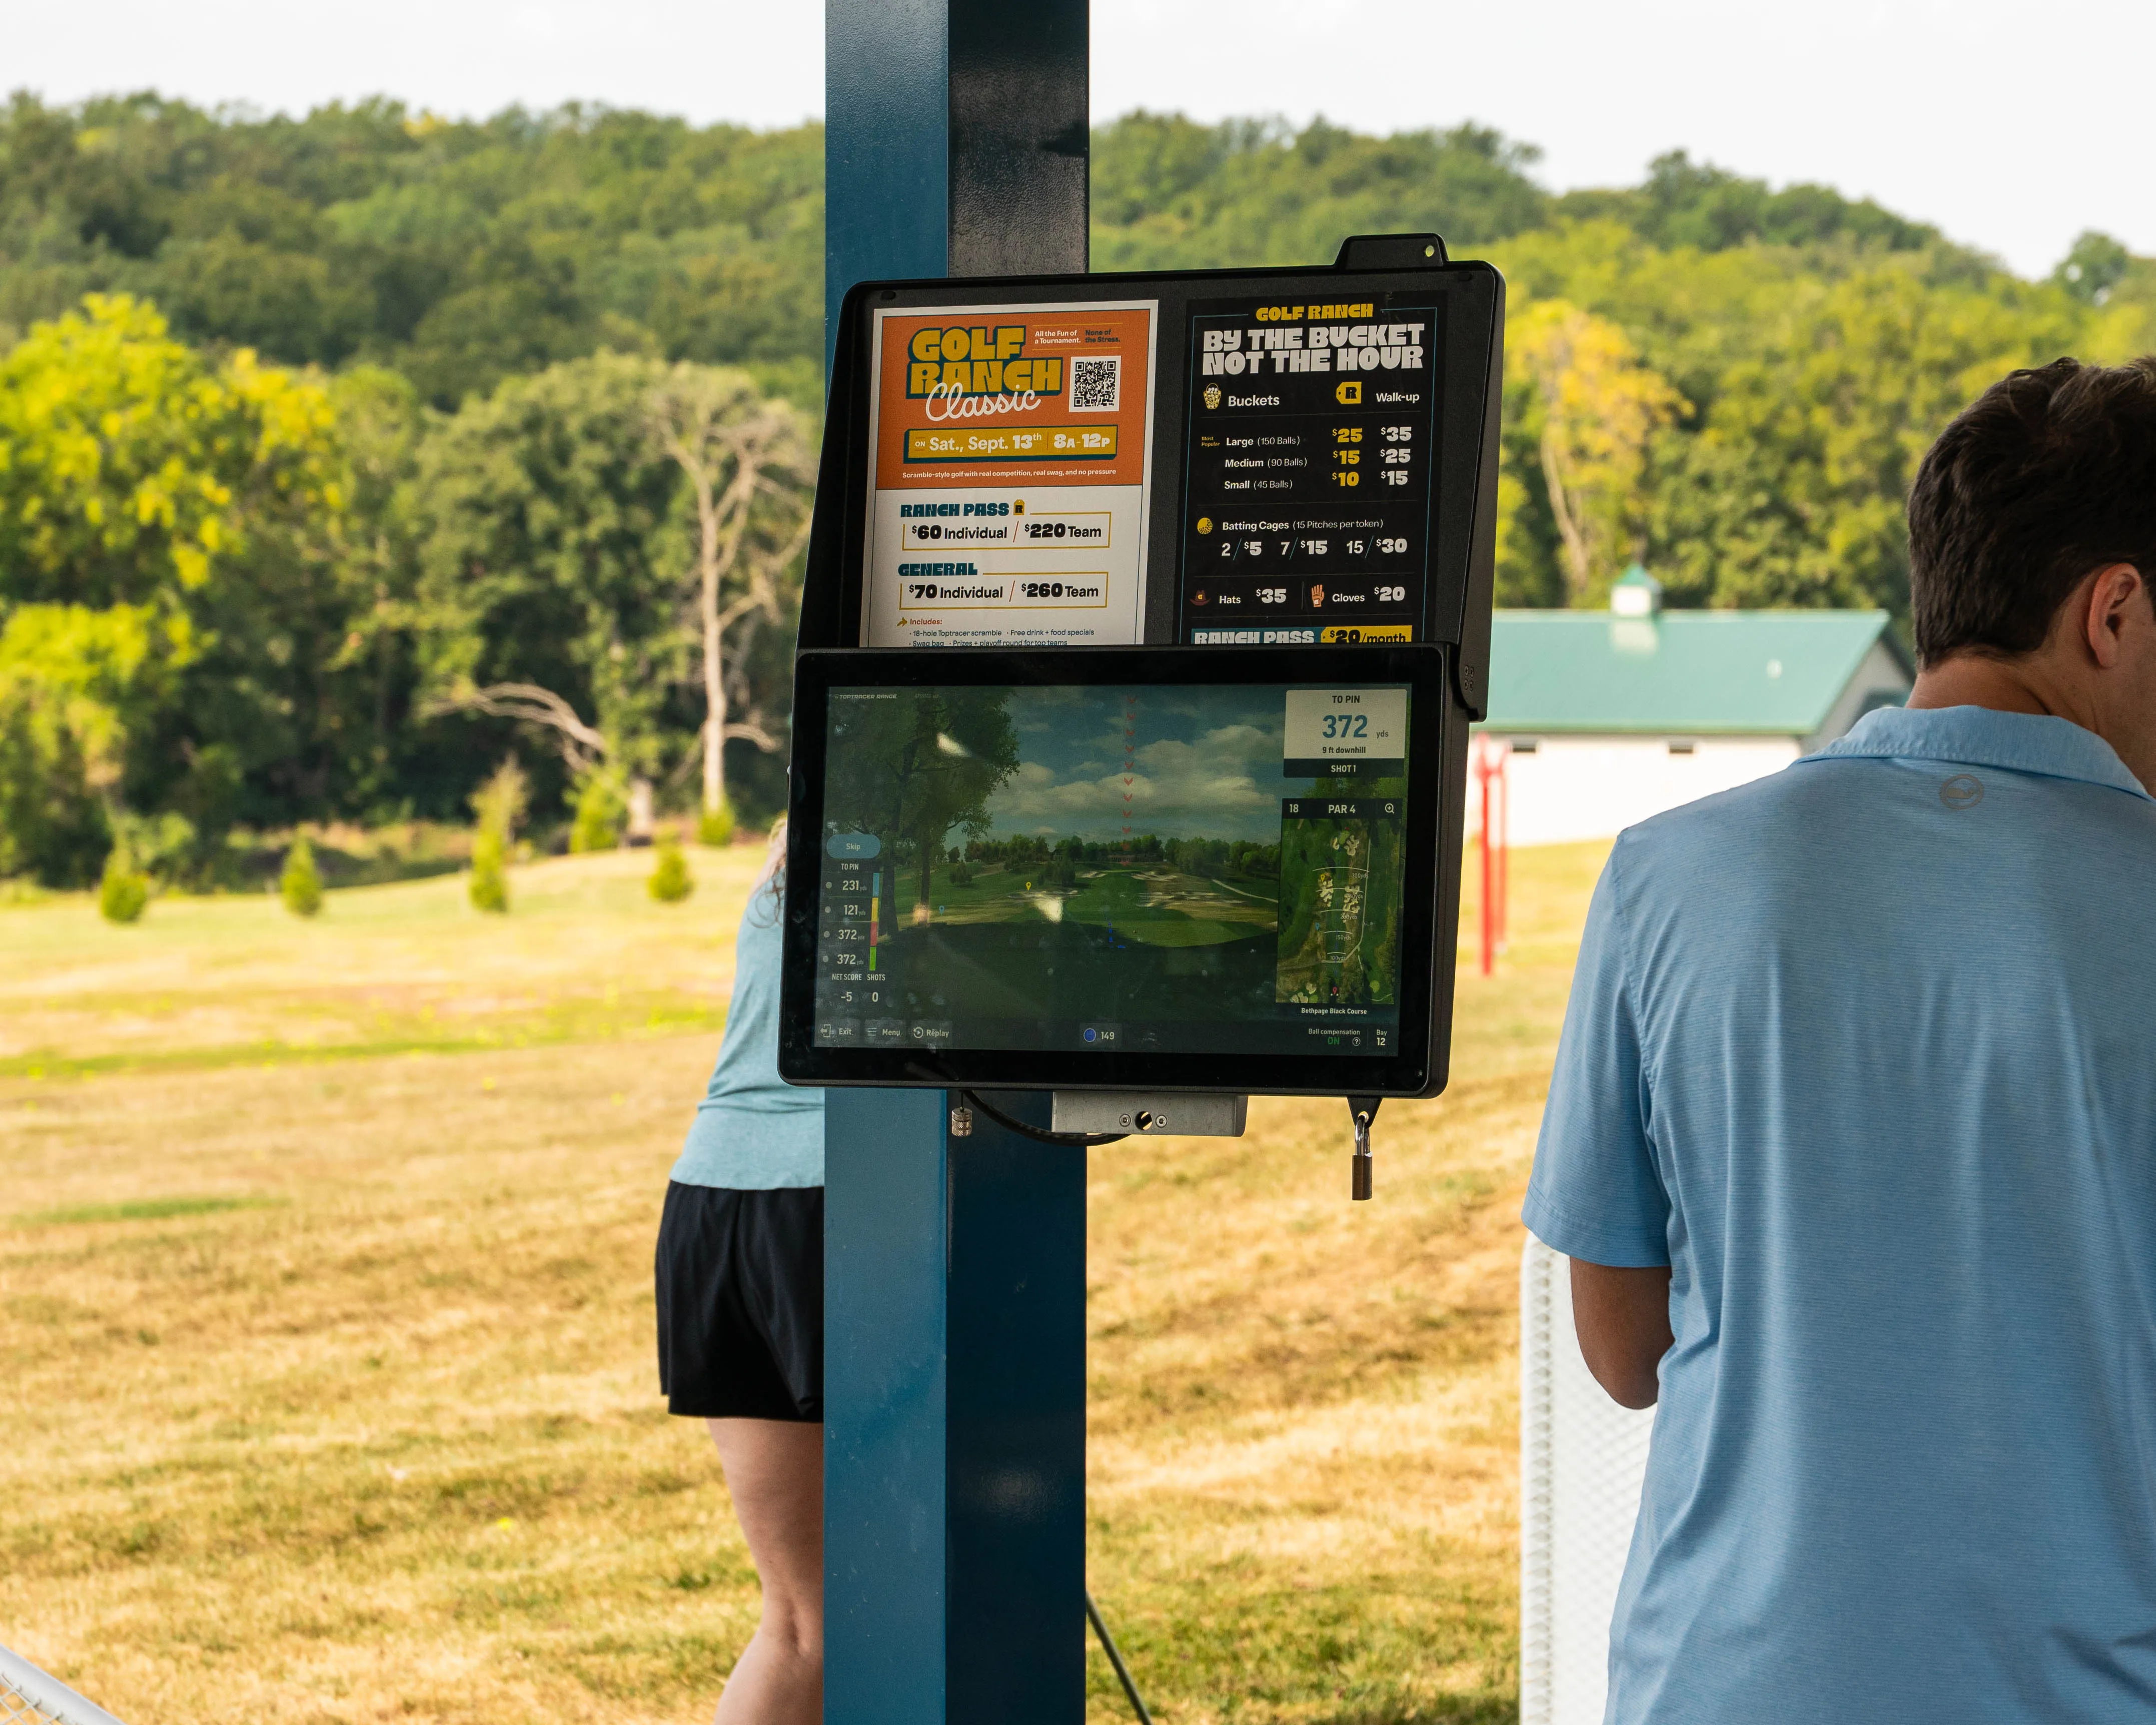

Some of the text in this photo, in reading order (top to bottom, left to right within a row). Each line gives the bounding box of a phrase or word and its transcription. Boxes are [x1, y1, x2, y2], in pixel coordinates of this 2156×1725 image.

[1256, 303, 1373, 321] GOLF RANCH
[910, 326, 1025, 361] GOLF
[1204, 323, 1424, 351] BY THE BUCKET
[1203, 346, 1423, 375] NOT THE HOUR
[908, 358, 1062, 396] RANCH
[925, 382, 1041, 421] Classic
[1228, 395, 1280, 407] Buckets
[1376, 392, 1420, 403] Walk-up
[929, 437, 963, 452] Sat.,
[968, 436, 1008, 453] Sept.
[1012, 434, 1042, 449] 13th
[1226, 426, 1412, 447] Large (150 Balls) $25 $35
[1225, 448, 1411, 468] Medium (90 Balls) $15 $25
[992, 470, 1032, 478] competition,
[1224, 470, 1408, 489] Small (45 Balls) $10 $15
[901, 503, 960, 517] RANCH
[964, 503, 1009, 517] PASS
[912, 523, 1101, 540] $60 Individual $220 Team
[1223, 519, 1383, 532] Batting Cages (15 Pitches per token)
[898, 563, 977, 576] GENERAL
[909, 583, 1099, 599] $70 Individual $260 Team
[1219, 586, 1405, 604] Hats $35 Gloves $20
[1067, 629, 1094, 637] specials
[1195, 631, 1260, 644] RANCH
[1264, 630, 1314, 643] PASS
[1332, 695, 1360, 703] TO PIN
[1323, 715, 1389, 739] 372 yds
[1290, 804, 1356, 813] 18 PAR 4
[846, 843, 860, 851] Skip
[840, 992, 878, 1002] -5 0
[926, 1029, 949, 1038] Replay
[1101, 1032, 1115, 1040] 149
[1327, 1037, 1386, 1046] ON 12
